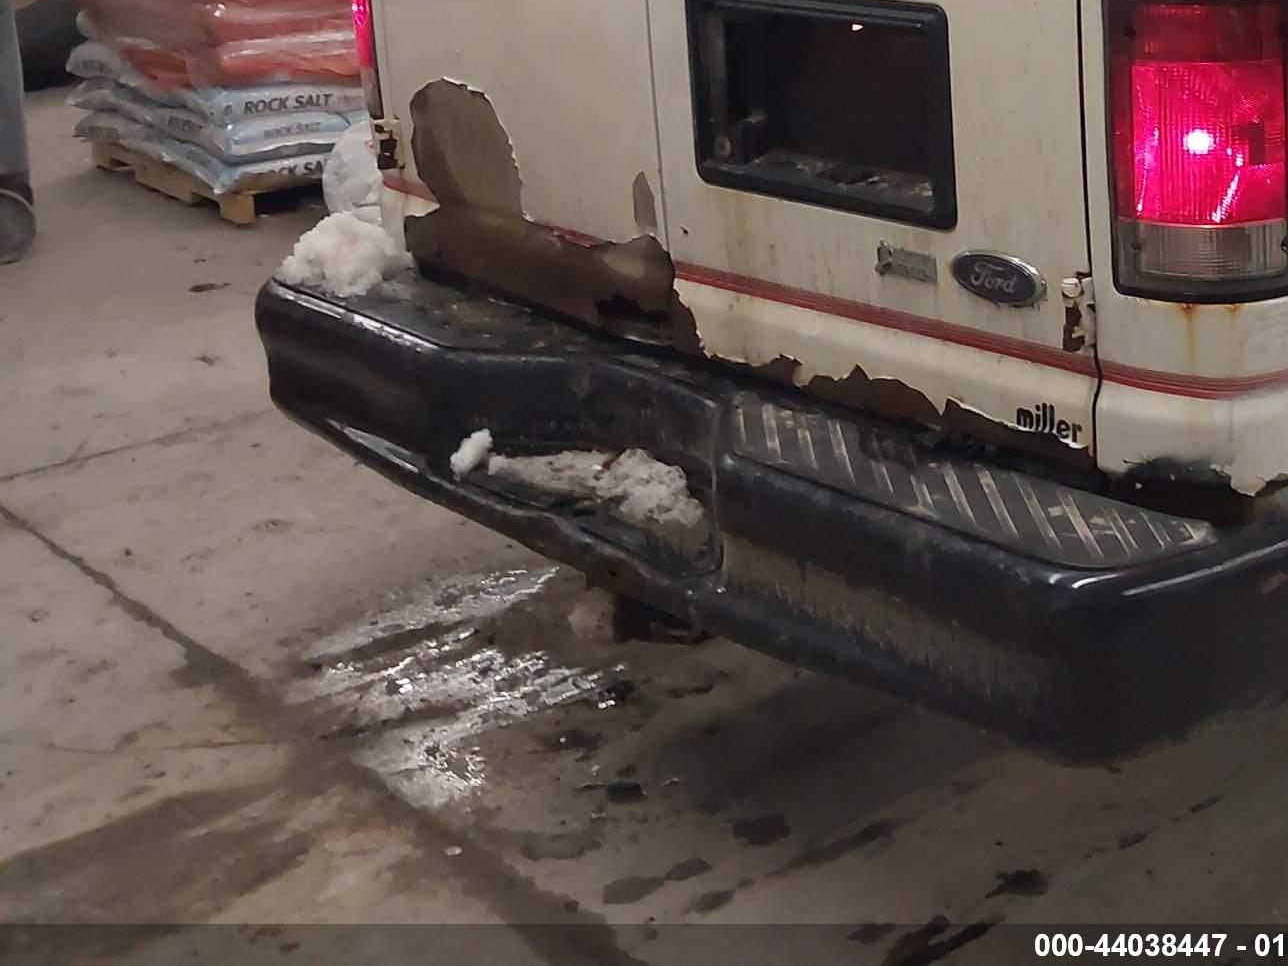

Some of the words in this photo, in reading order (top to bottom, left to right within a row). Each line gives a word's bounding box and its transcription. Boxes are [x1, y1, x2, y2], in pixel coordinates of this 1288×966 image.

[244, 96, 289, 115] ROCK
[293, 93, 333, 109] SALT
[970, 261, 1017, 294] Ford
[1016, 402, 1083, 443] miller
